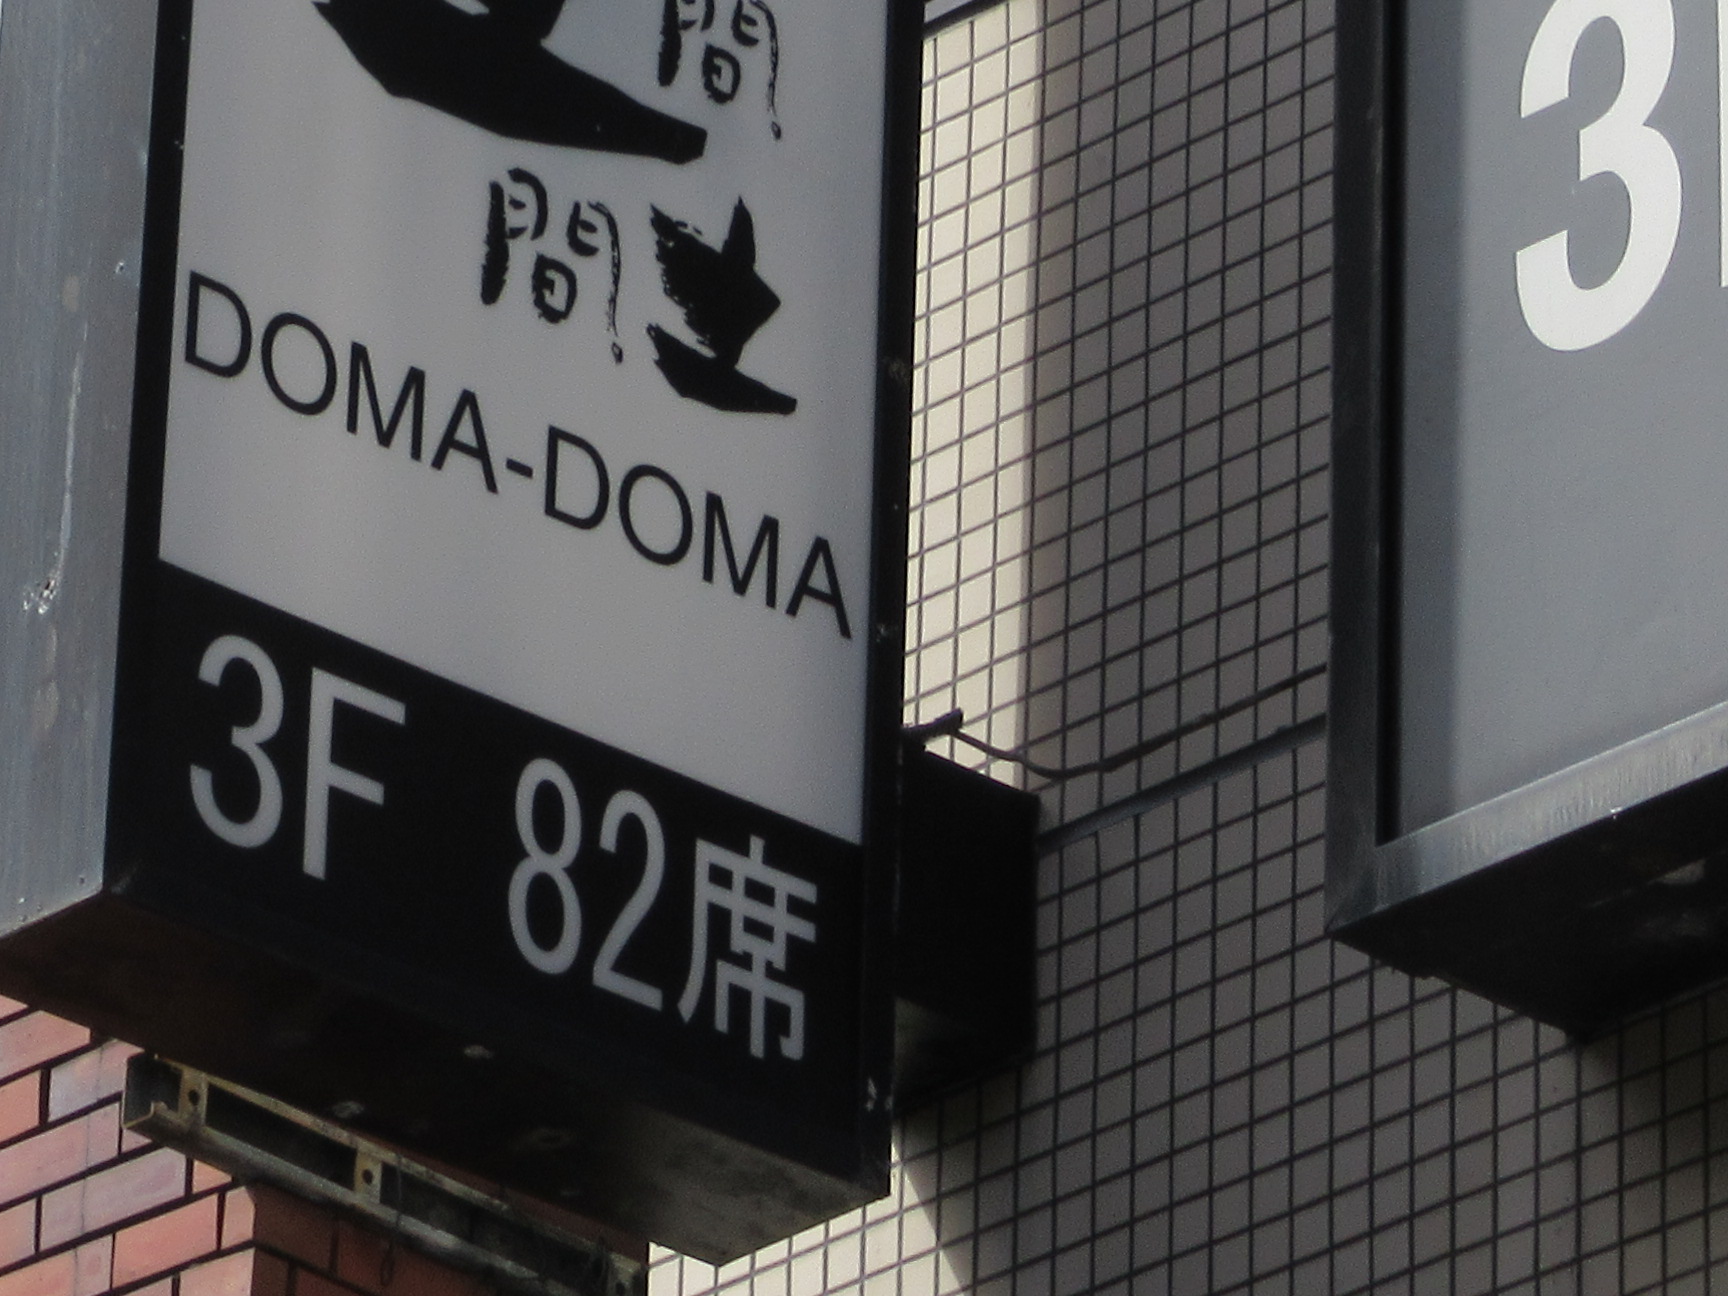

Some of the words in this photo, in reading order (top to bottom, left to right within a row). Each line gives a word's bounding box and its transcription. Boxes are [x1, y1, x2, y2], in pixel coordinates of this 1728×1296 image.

[184, 271, 852, 639] DOMA-DOMA
[188, 633, 406, 879] 3F
[508, 757, 817, 1060] 82席
